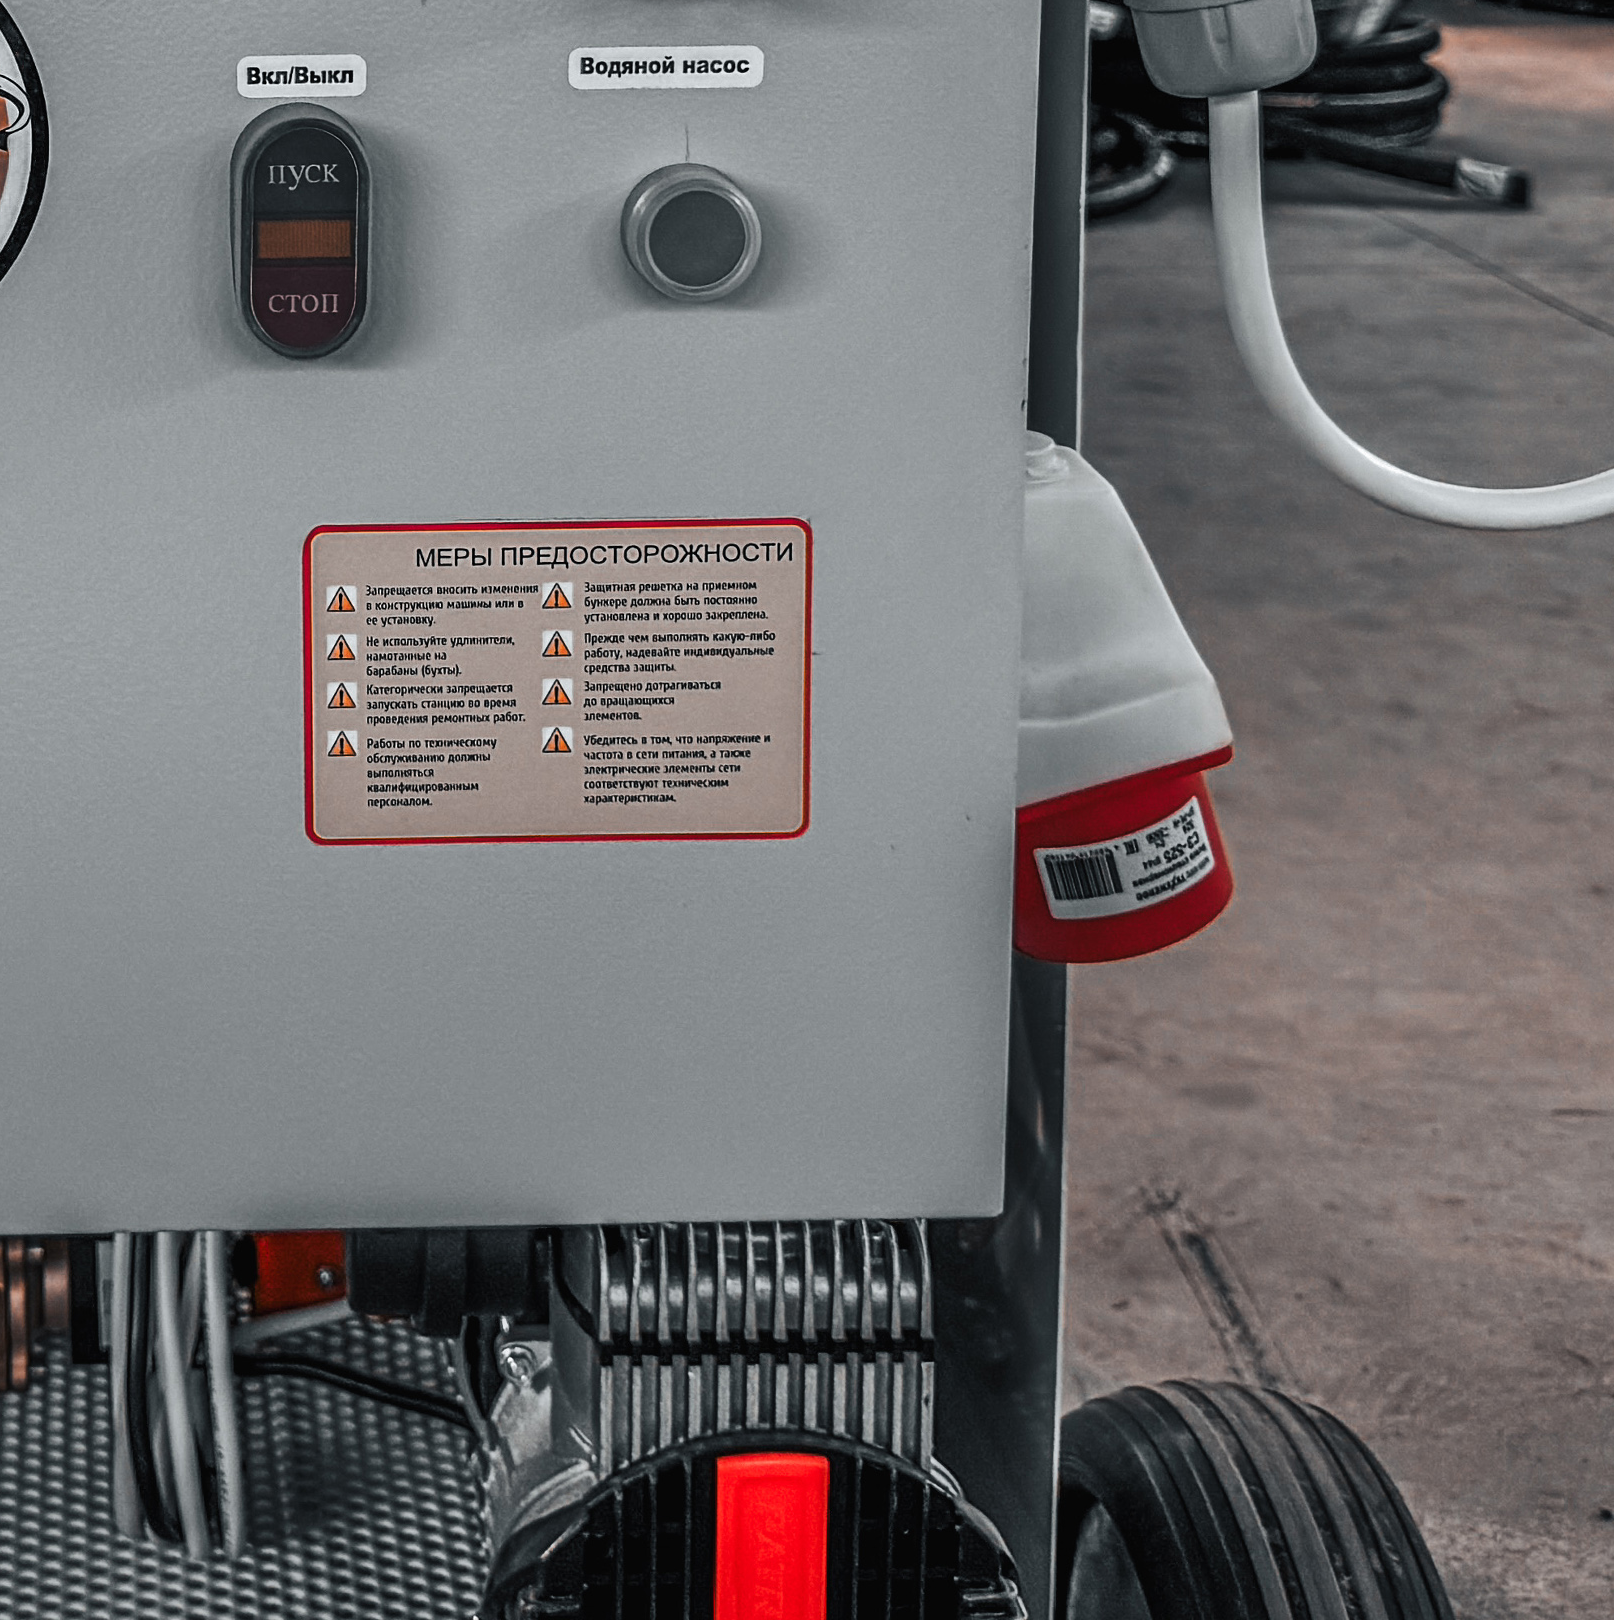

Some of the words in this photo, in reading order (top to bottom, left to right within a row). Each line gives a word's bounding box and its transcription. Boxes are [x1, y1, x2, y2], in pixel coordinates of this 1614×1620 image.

[580, 55, 675, 78] Водяной
[682, 59, 750, 74] насос
[246, 66, 354, 85] Вкл/Выкл
[268, 164, 339, 191] ПУСК
[268, 293, 339, 313] СТОП
[416, 547, 492, 568] МЕРЫ
[501, 542, 793, 570] ПРЕДОСТОРОЖНОСТИ
[365, 584, 433, 599] Запрещается
[436, 586, 479, 595] вносить
[481, 584, 539, 595] изменения
[584, 581, 636, 594] Защитная
[638, 582, 683, 595] решетка
[686, 582, 699, 591] на
[702, 581, 758, 593] приемном
[375, 601, 444, 613] конструкцию
[446, 600, 492, 610] машины
[494, 600, 515, 609] или
[584, 596, 628, 610] бункере
[629, 597, 671, 608] должна
[674, 594, 701, 606] быть
[703, 596, 758, 606] постоянно
[366, 617, 378, 626] ее
[583, 612, 650, 625] установлена
[662, 612, 703, 624] хорошо
[366, 635, 380, 648] Не
[382, 635, 448, 649] используйте
[584, 632, 625, 647] Прежде
[627, 634, 649, 643] чем
[652, 633, 710, 643] выполнять
[712, 629, 776, 645] какую-либо
[366, 652, 432, 662] намотанные
[434, 651, 447, 661] на
[625, 646, 681, 659] надевайте
[683, 646, 775, 659] индивидуальные
[366, 664, 418, 679] барабаны
[583, 663, 631, 676] средства
[366, 684, 444, 697] Категорически
[446, 684, 513, 697] запрещается
[584, 680, 643, 694] Запрещено
[644, 681, 722, 693] дотрагиваться
[366, 700, 418, 713] запускать
[421, 699, 465, 710] станцию
[468, 699, 481, 709] во
[483, 698, 517, 711] время
[582, 697, 598, 709] до
[600, 696, 675, 709] вращающихся
[366, 715, 429, 727] проведения
[431, 714, 491, 726] ремонтных
[366, 737, 406, 750] Работы
[408, 739, 422, 749] по
[424, 738, 498, 750] техническому
[583, 734, 639, 747] Убедитесь
[675, 735, 694, 745] что
[696, 734, 762, 746] напряжение
[366, 752, 446, 766] обслуживанию
[447, 753, 491, 764] должны
[583, 750, 624, 761] частота
[635, 750, 659, 760] сети
[719, 749, 752, 759] также
[366, 768, 435, 779] выполняться
[583, 765, 661, 778] электрические
[663, 764, 716, 774] элементы
[718, 764, 741, 773] сети
[366, 781, 479, 795] квалифицированным
[583, 779, 659, 792] соответствуют
[661, 778, 730, 789] техническим
